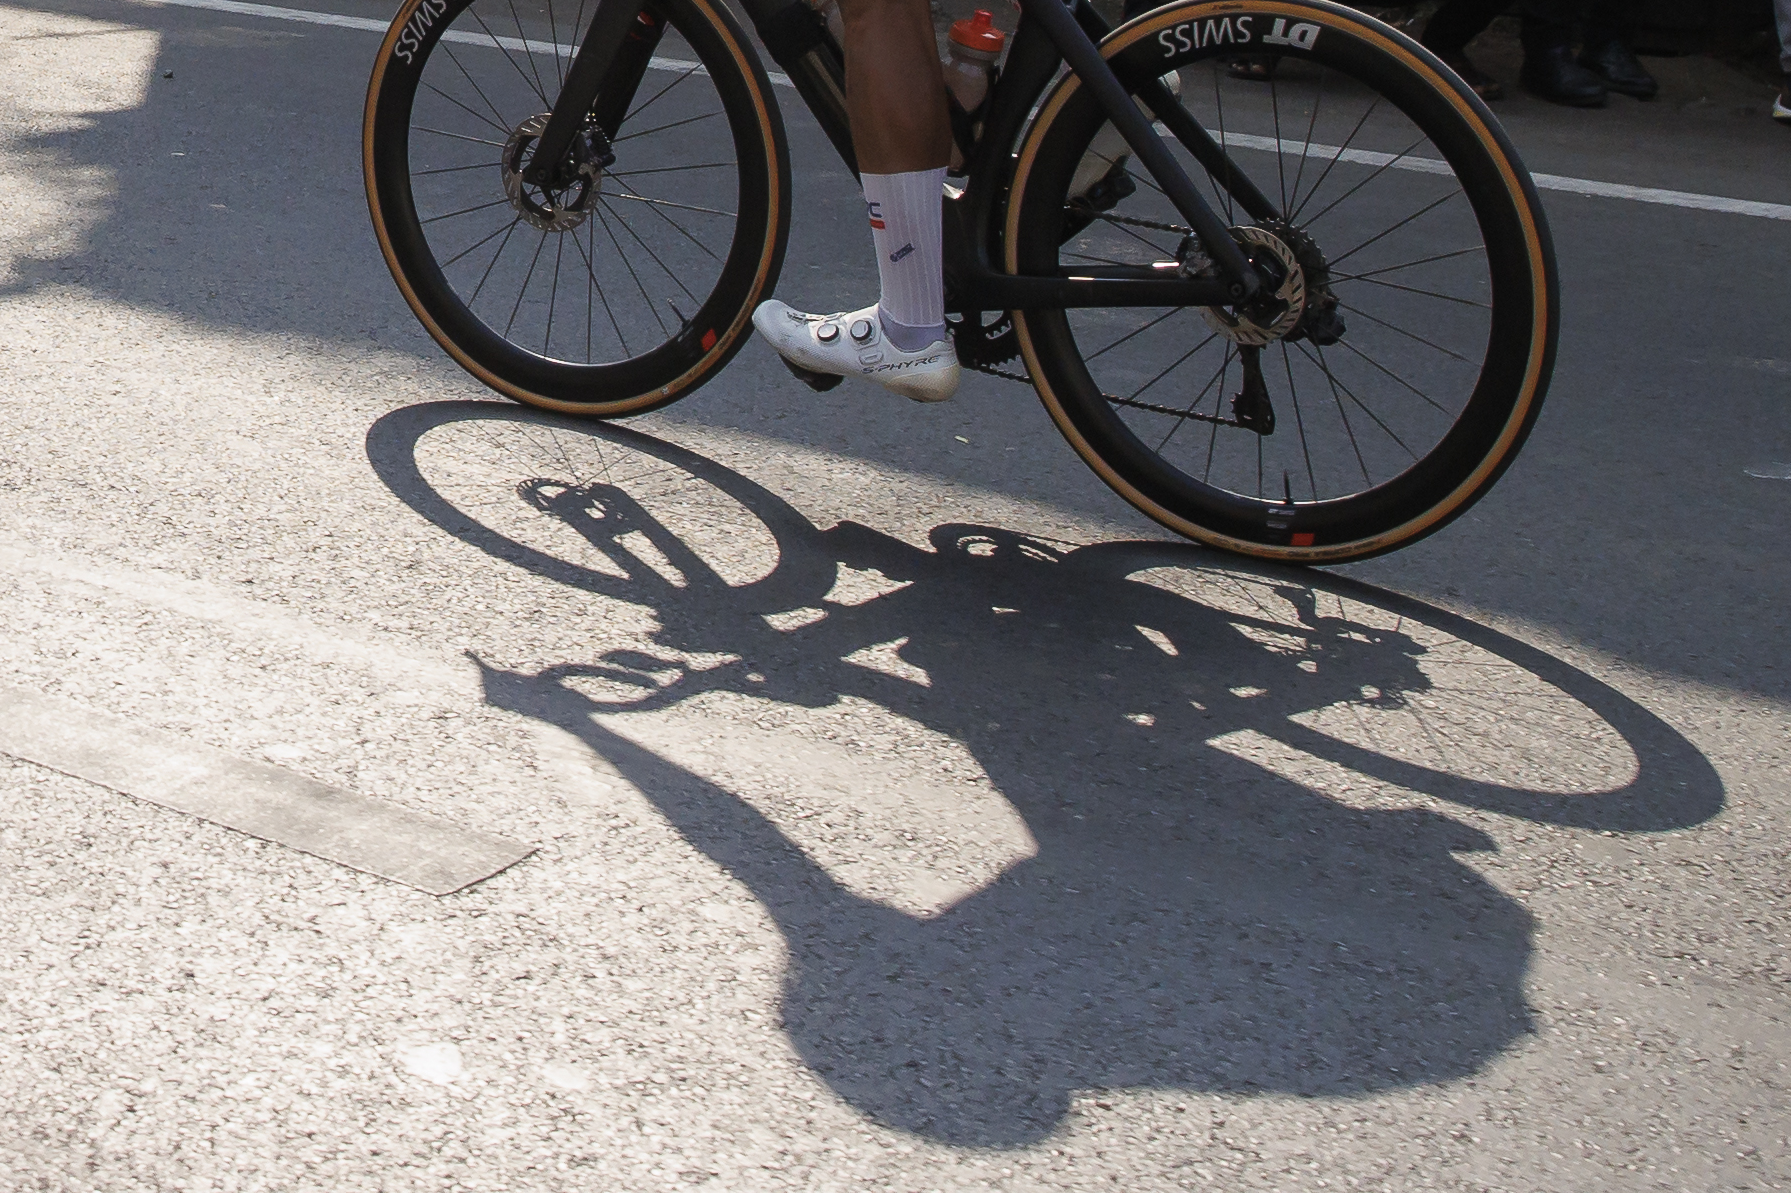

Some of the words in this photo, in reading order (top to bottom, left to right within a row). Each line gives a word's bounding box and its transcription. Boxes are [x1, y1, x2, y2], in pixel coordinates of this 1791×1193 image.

[1158, 16, 1253, 58] SWISS
[1262, 17, 1321, 51] DT
[861, 354, 942, 375] S-PHYRE
